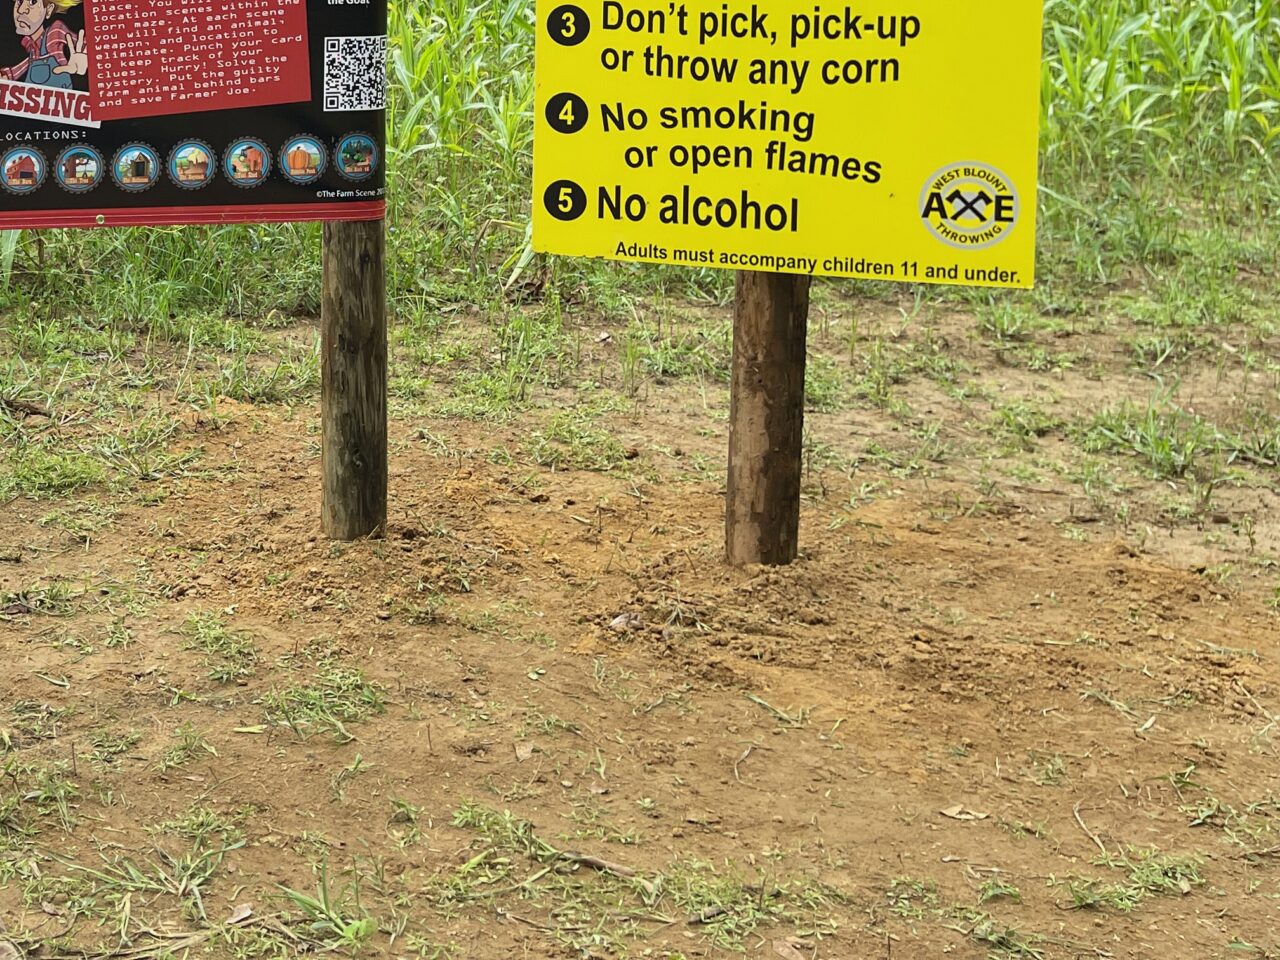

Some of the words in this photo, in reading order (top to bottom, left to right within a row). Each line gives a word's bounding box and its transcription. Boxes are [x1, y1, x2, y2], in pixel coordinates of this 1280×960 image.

[561, 12, 576, 37] 3
[699, 4, 777, 45] pick,
[791, 6, 920, 47] pick-up
[601, 48, 633, 72] or
[644, 46, 736, 83] throw
[748, 59, 809, 94] any
[821, 57, 900, 85] corn
[558, 100, 574, 125] 4
[600, 102, 647, 132] No
[660, 100, 815, 141] smoking
[624, 145, 658, 168] or
[669, 141, 752, 173] open
[765, 141, 881, 184] flames
[933, 169, 961, 190] WEST
[964, 168, 1007, 192] BLOUNT
[336, 190, 354, 198] Farm
[355, 189, 375, 197] Scene
[558, 187, 572, 213] 5
[597, 185, 646, 222] No
[659, 185, 799, 232] alcohol
[936, 222, 1002, 244] THROWING
[615, 241, 668, 259] Adults
[673, 247, 715, 264] must
[719, 252, 818, 273] accompany
[823, 256, 894, 275] children
[901, 260, 918, 277] 11
[925, 264, 958, 279] and
[965, 266, 1020, 283] under.
